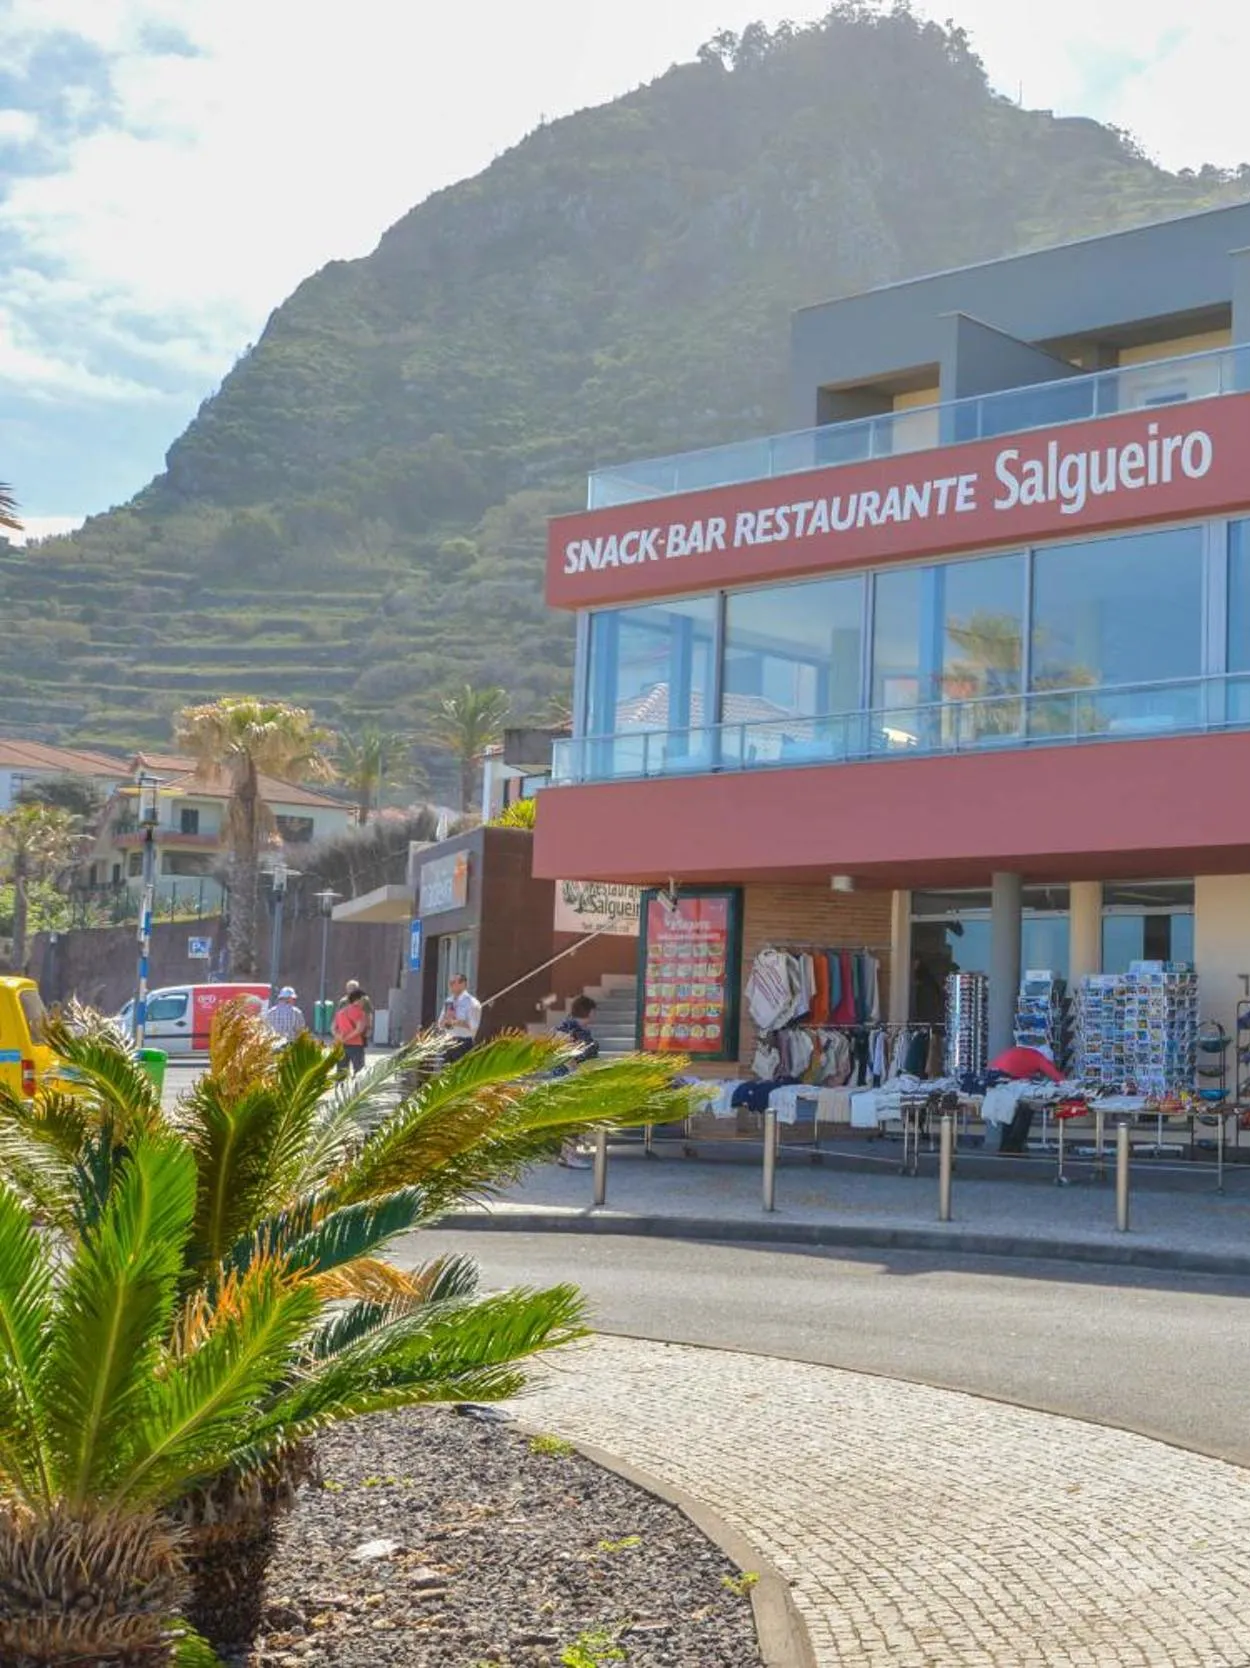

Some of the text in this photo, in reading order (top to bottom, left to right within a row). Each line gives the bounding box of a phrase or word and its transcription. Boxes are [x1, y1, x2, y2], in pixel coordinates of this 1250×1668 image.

[563, 422, 1213, 574] SNACK-BAR RESTAURANTE Salgueiro
